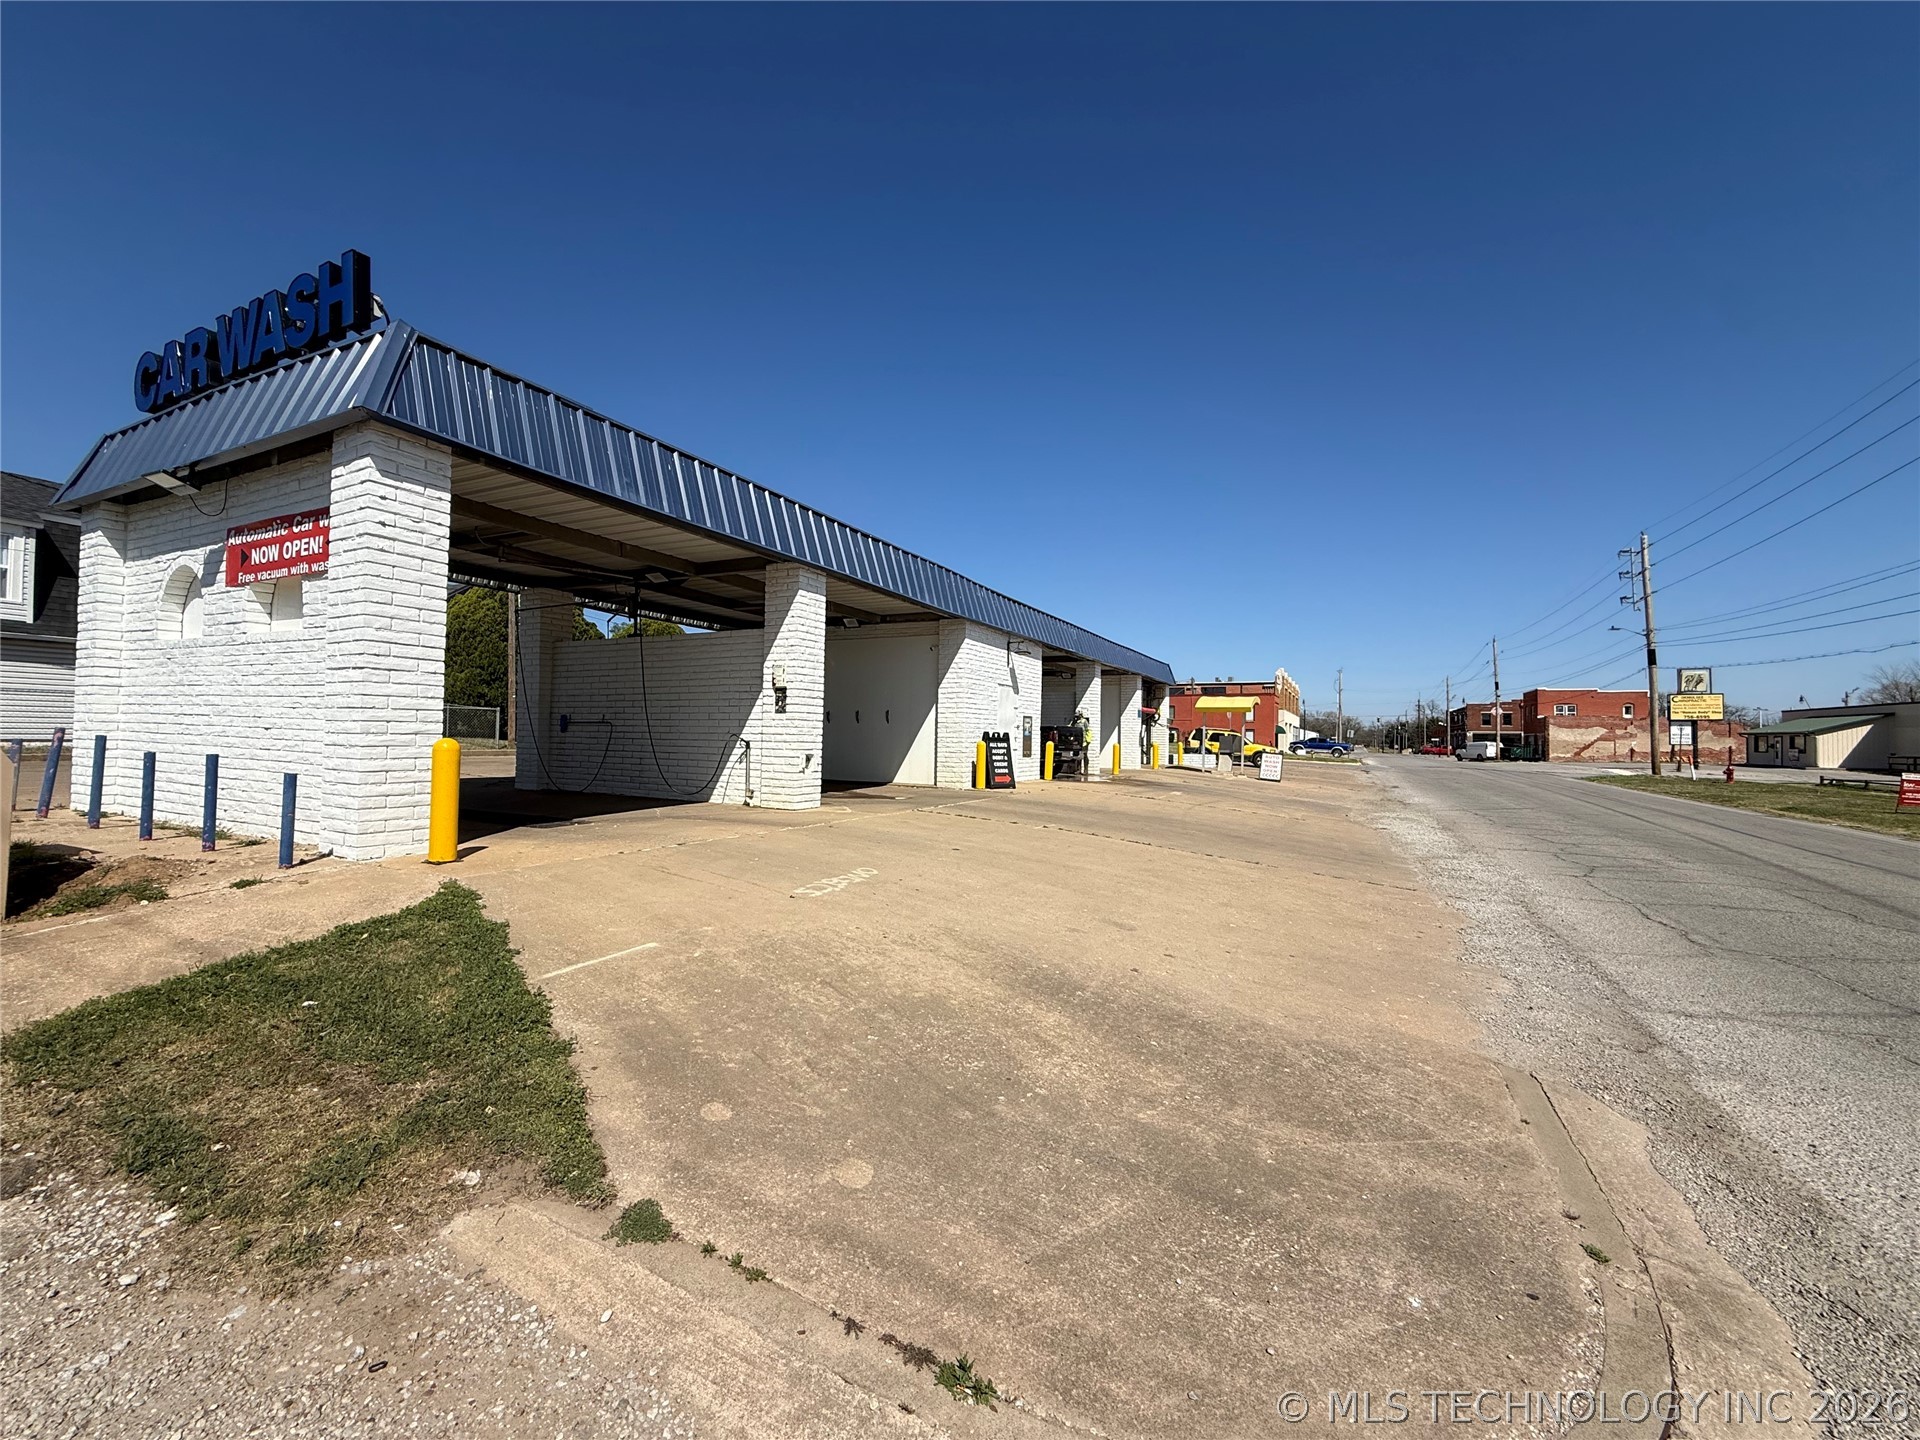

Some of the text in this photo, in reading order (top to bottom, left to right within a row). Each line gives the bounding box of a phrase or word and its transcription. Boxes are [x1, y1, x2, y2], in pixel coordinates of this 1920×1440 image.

[134, 248, 363, 413] CAR WASH
[227, 520, 289, 546] Automatic
[292, 515, 316, 534] Car
[251, 535, 324, 565] NOW OPEN!
[238, 560, 330, 584] Free vacuum with was
